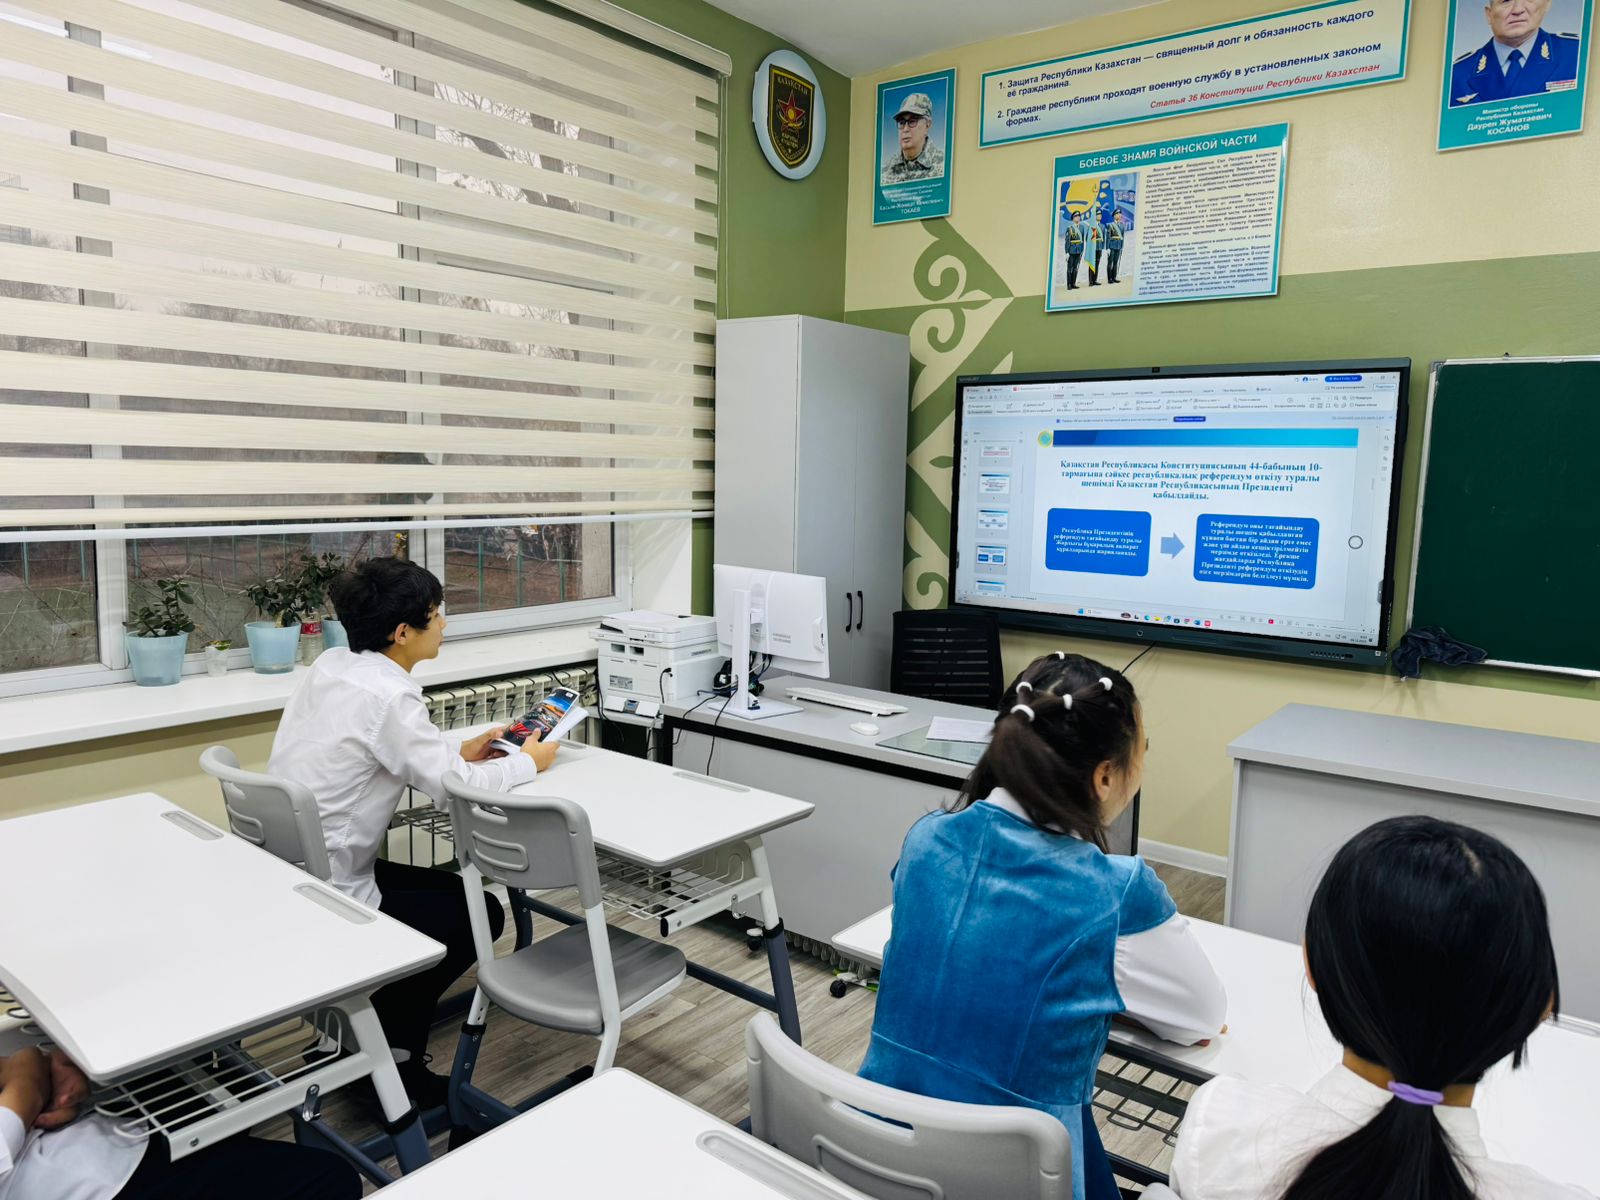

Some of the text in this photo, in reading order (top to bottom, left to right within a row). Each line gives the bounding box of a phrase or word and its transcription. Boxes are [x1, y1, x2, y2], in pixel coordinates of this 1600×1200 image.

[998, 81, 1006, 90] 1.
[1007, 76, 1039, 89] Защита
[1041, 65, 1093, 82] Республики
[1094, 55, 1142, 71] Казахстан
[1156, 39, 1214, 60] священный
[1216, 35, 1242, 49] долг
[1243, 34, 1251, 43] и
[1253, 20, 1324, 40] обязанность
[1326, 9, 1375, 26] каждого
[997, 42, 1382, 119] 2. Граждане республики проходят военную службу в установленных законом
[1149, 63, 1381, 109] Статья 36 Конституции Республики Казахстан
[1007, 80, 1071, 98] её гражданина.
[1512, 107, 1545, 117] Казахстан
[1005, 114, 1041, 127] формах.
[1467, 121, 1498, 132] Даурен
[1487, 124, 1530, 136] КОСАНОВ
[1078, 154, 1119, 169] БОЕВОЕ
[1121, 149, 1157, 162] ЗНАМЯ
[1220, 132, 1258, 147] ЧАСТИ
[1101, 460, 1158, 470] Республикасы
[1308, 463, 1323, 471] 10-
[1200, 471, 1252, 481] референдум
[1285, 474, 1320, 482] туралы
[1081, 480, 1115, 488] шешімді
[1242, 482, 1293, 492] Президенті
[1210, 520, 1248, 529] Референдум
[1237, 564, 1277, 573] референдум
[1256, 558, 1295, 567] Республика
